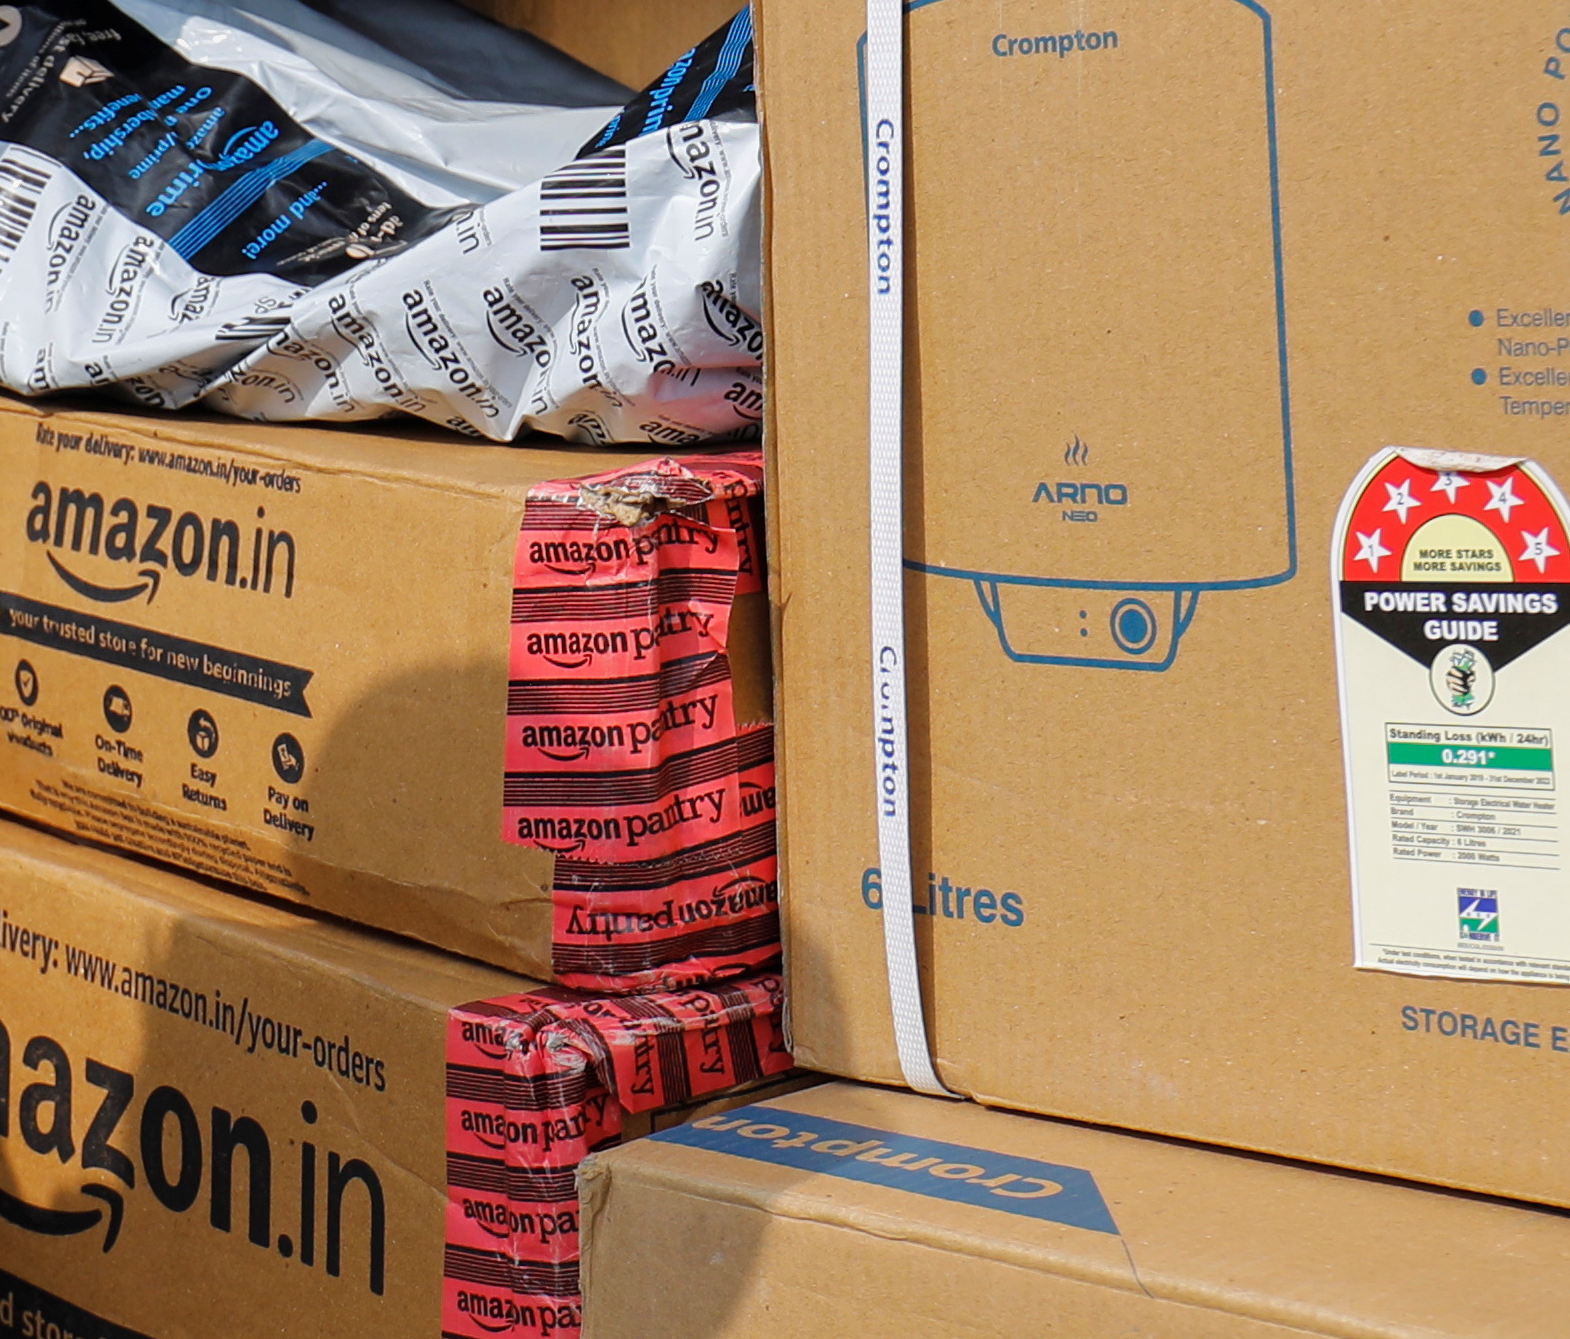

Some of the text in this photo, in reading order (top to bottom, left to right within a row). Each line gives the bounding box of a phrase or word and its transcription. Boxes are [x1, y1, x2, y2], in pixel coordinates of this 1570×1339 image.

[992, 28, 1118, 58] Crompton
[873, 118, 895, 295] Crompton
[92, 235, 155, 344] amazon.in
[403, 289, 499, 421] amazon.in
[57, 431, 80, 451] your
[86, 431, 135, 466] delivery:
[138, 448, 301, 493] www.amazon.in/your-orders
[1032, 482, 1128, 507] ARNO
[1397, 493, 1404, 505] 2
[1499, 492, 1507, 504] 4
[26, 481, 296, 598] amazon.in
[529, 538, 630, 564] amazon
[1534, 542, 1542, 555] 5
[1413, 562, 1501, 572] MORE SAVINGS
[1419, 550, 1493, 559] MORE STARS
[1364, 592, 1557, 613] POWER SAVINGS
[10, 609, 40, 628] your
[43, 616, 95, 644] trusted
[100, 627, 136, 656] store
[141, 638, 163, 662] for
[167, 650, 199, 670] new
[1423, 620, 1499, 640] GUIDE
[527, 632, 628, 655] amazon
[96, 735, 143, 762] On-Time
[523, 725, 624, 748] amazon
[1390, 729, 1441, 742] Standing
[1445, 731, 1472, 741] Loss
[1517, 734, 1548, 747] 24hr)
[98, 757, 142, 788] Delivery
[191, 763, 216, 788] Easy
[182, 784, 226, 811] Returns
[268, 787, 308, 812] Pay on
[263, 810, 314, 841] Delivery
[518, 817, 621, 840] amazon
[65, 942, 387, 1093] www.amazon.in/your-orders
[1401, 1006, 1540, 1048] STORAGE
[693, 1115, 1062, 1200] Crompton
